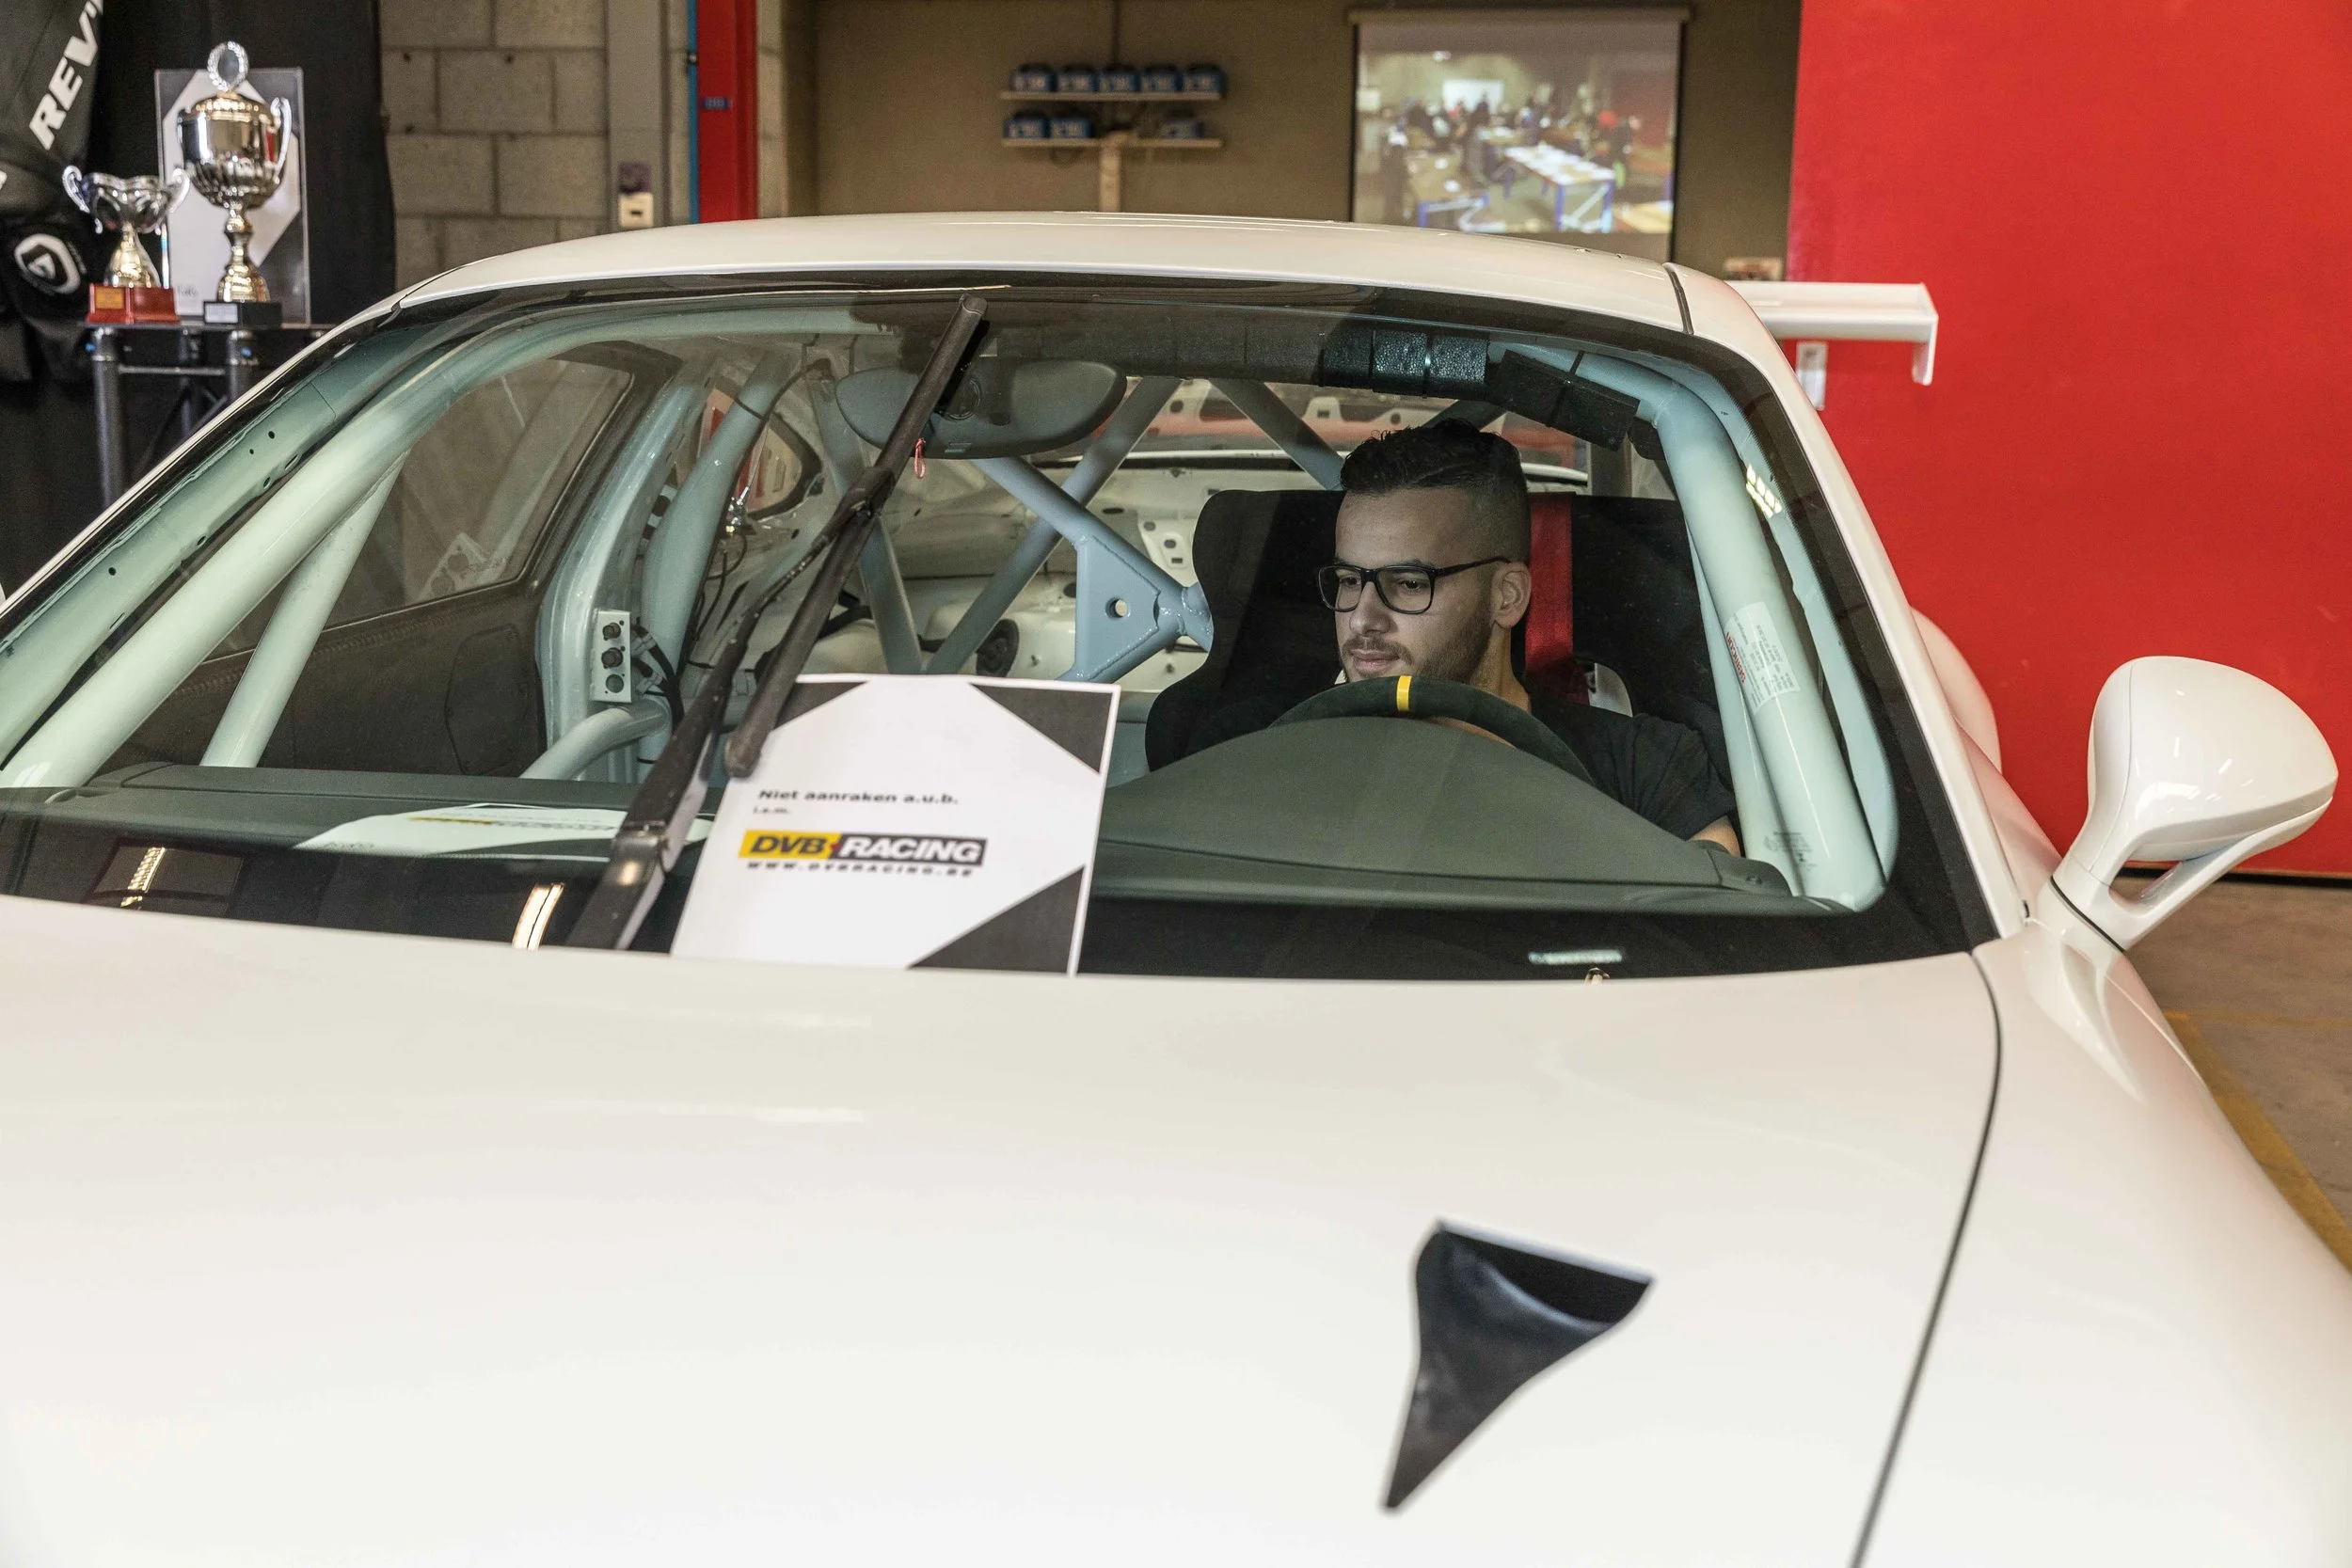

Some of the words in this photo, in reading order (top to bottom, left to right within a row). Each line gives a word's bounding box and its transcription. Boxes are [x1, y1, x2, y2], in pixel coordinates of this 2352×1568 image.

[29, 0, 103, 150] REV'
[758, 789, 798, 800] Niet
[804, 790, 898, 803] aanraken
[903, 792, 958, 805] a.u.b.
[750, 835, 828, 855] DVB
[839, 836, 981, 863] RACING
